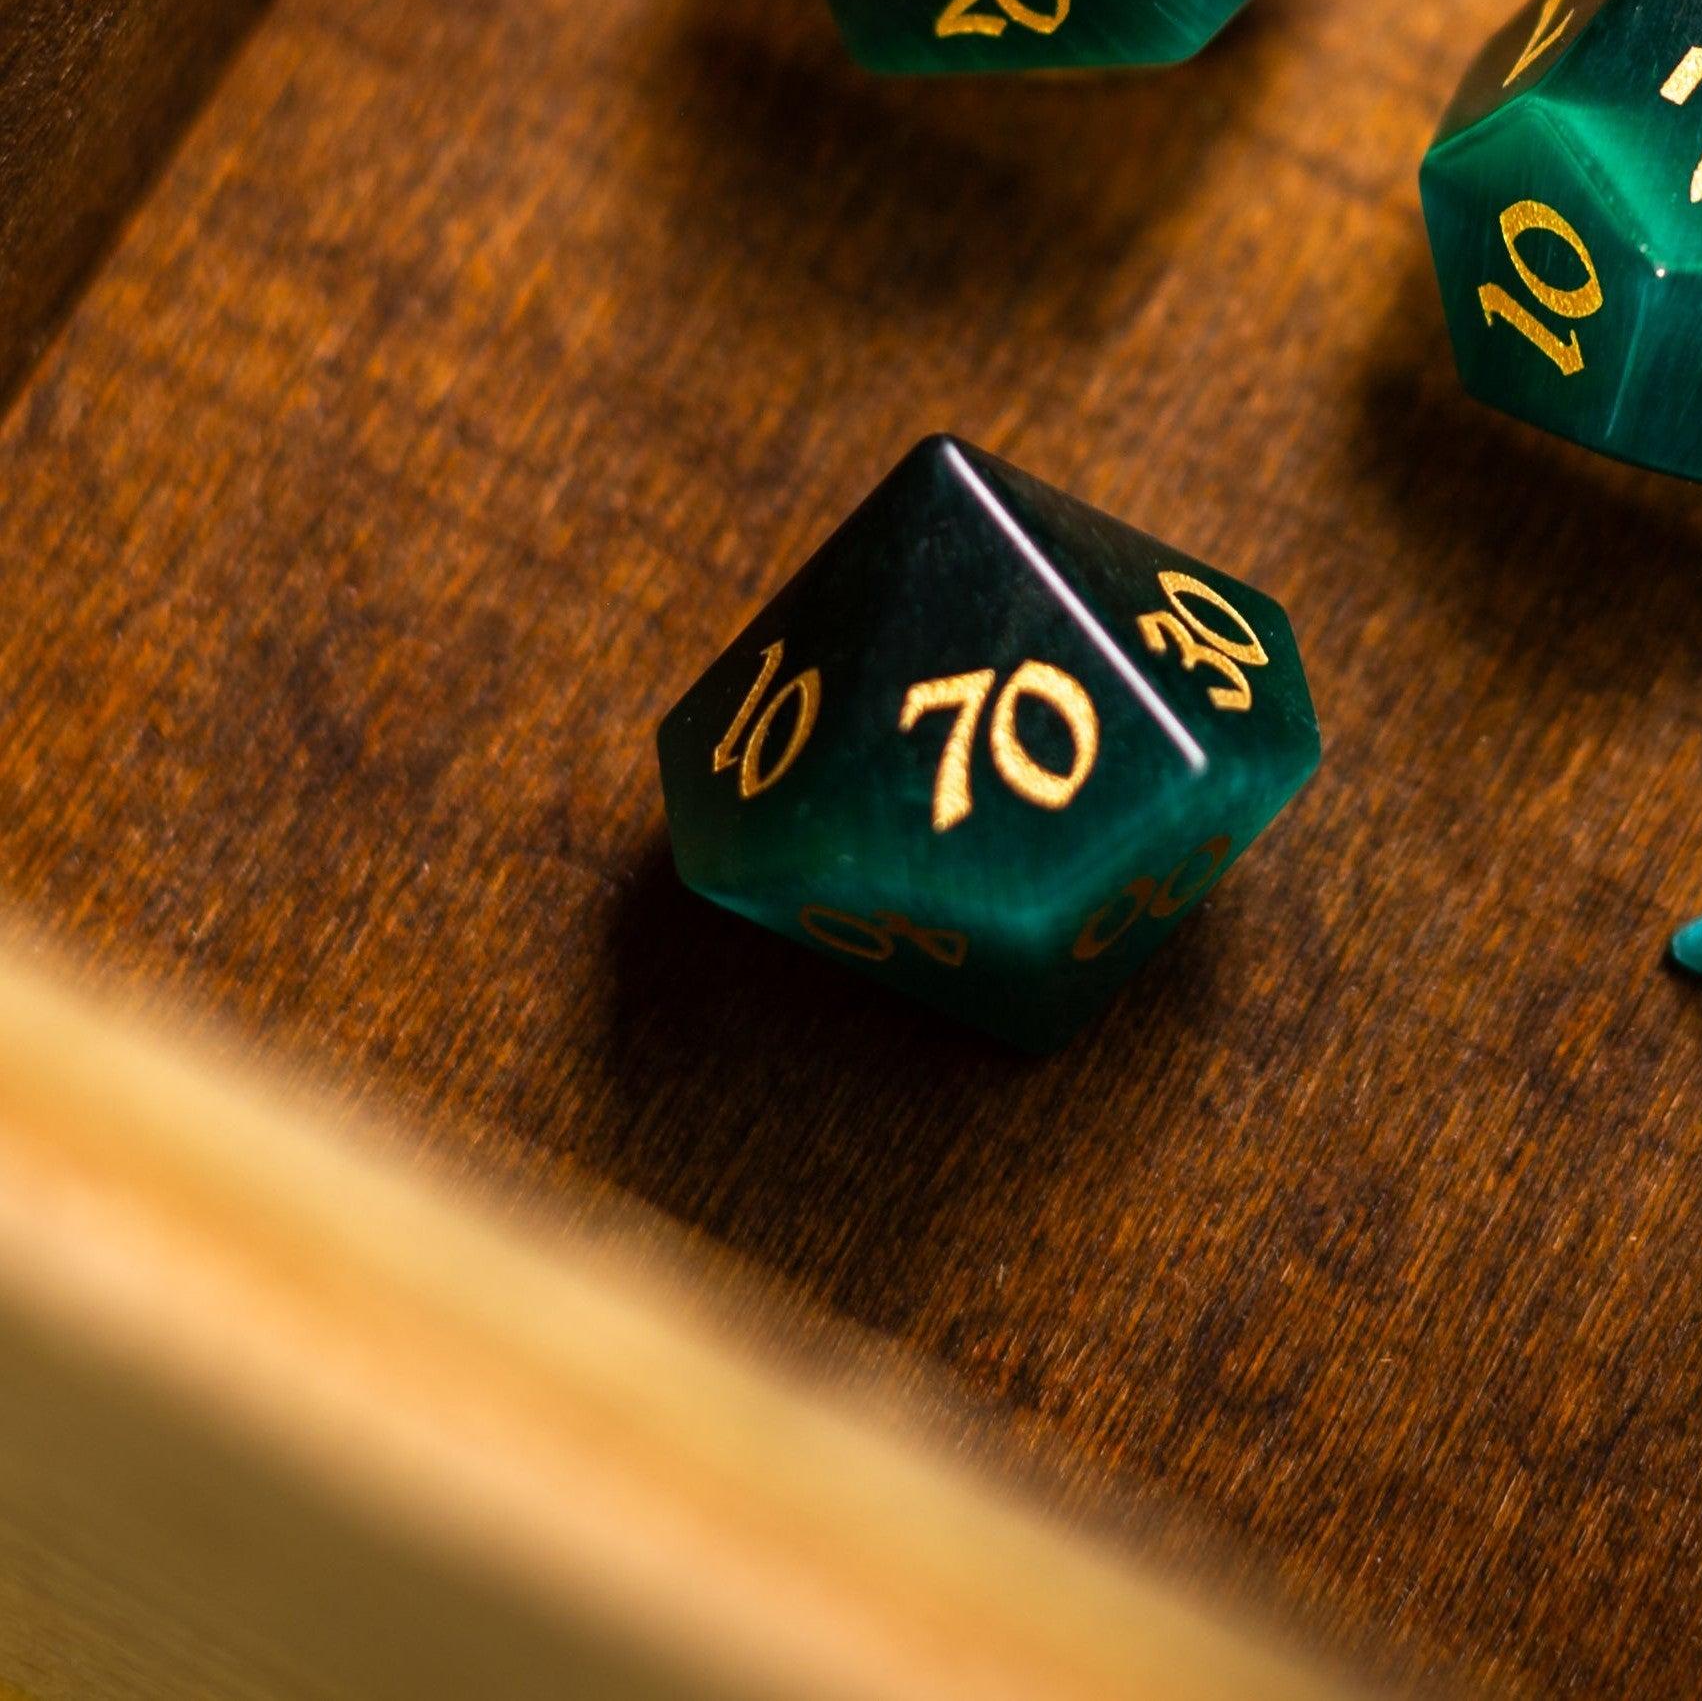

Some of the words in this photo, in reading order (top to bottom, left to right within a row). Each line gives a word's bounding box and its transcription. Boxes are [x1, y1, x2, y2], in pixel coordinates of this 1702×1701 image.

[1478, 200, 1603, 376] 10
[713, 637, 822, 798] 10
[1137, 570, 1269, 712] 30
[900, 659, 1099, 834] 70
